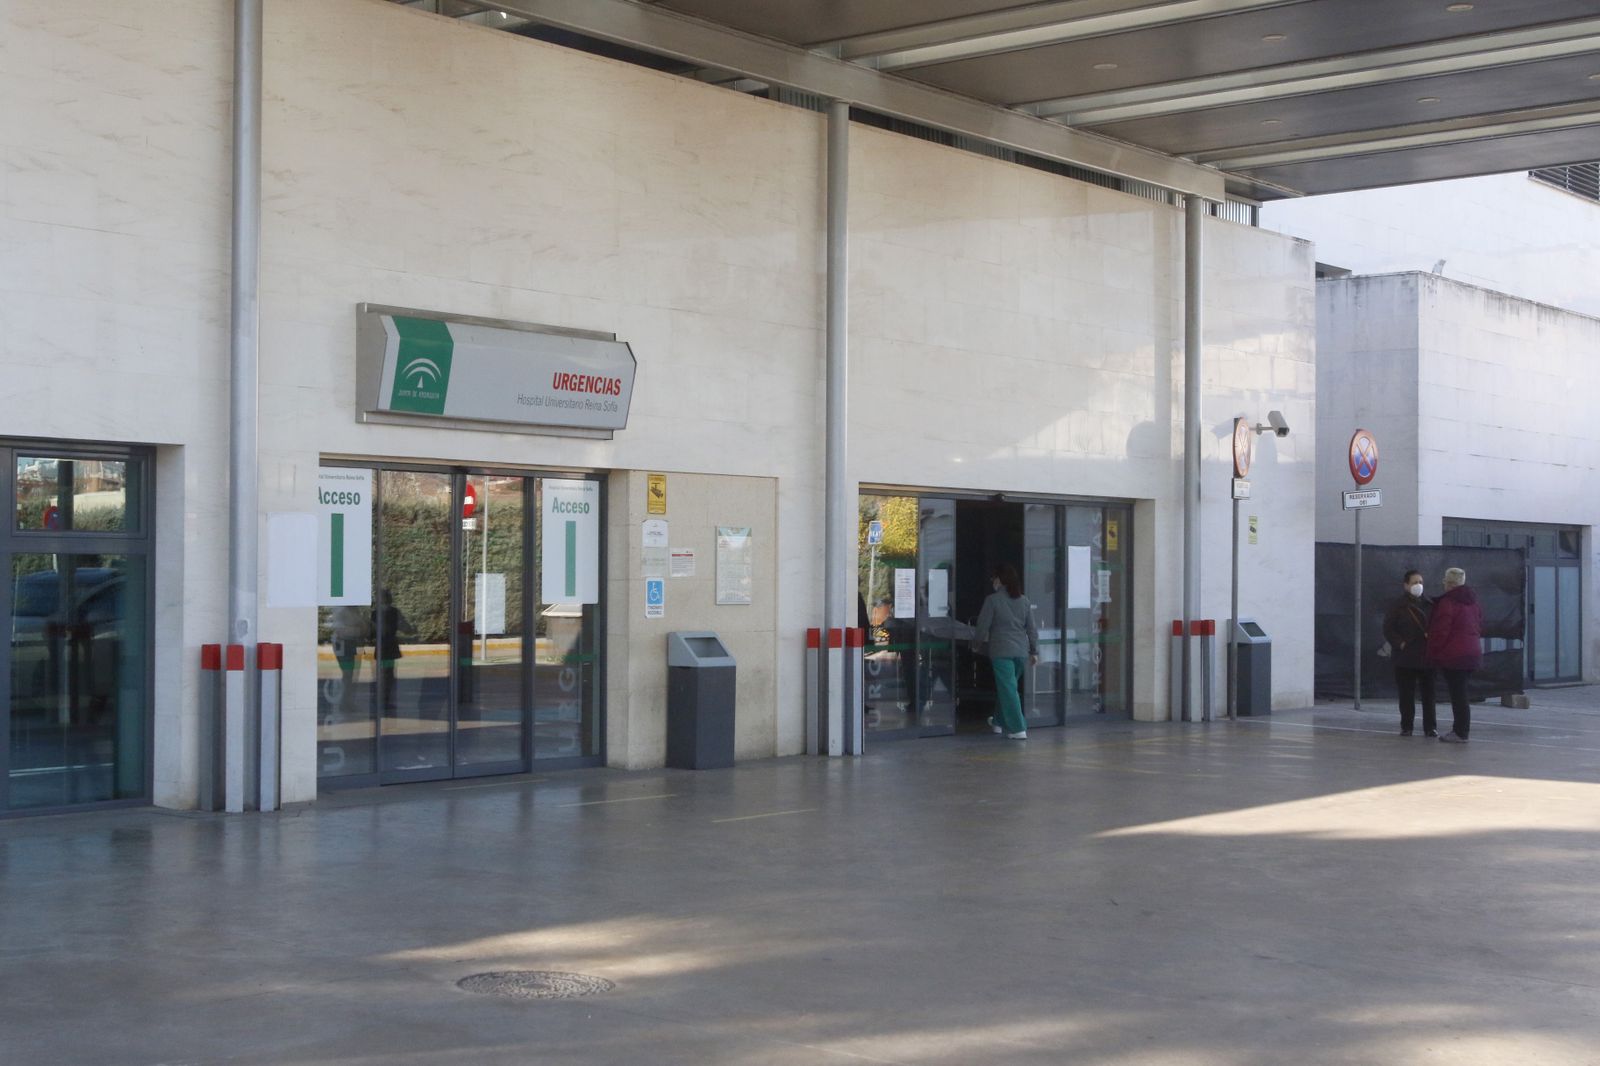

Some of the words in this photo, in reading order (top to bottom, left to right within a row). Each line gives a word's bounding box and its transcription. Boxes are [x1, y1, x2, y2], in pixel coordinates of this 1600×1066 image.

[552, 372, 621, 396] URGENCIAS
[517, 393, 544, 406] Hospital
[544, 395, 584, 410] Universitario
[584, 398, 602, 411] Reina
[552, 496, 590, 514] Acceso
